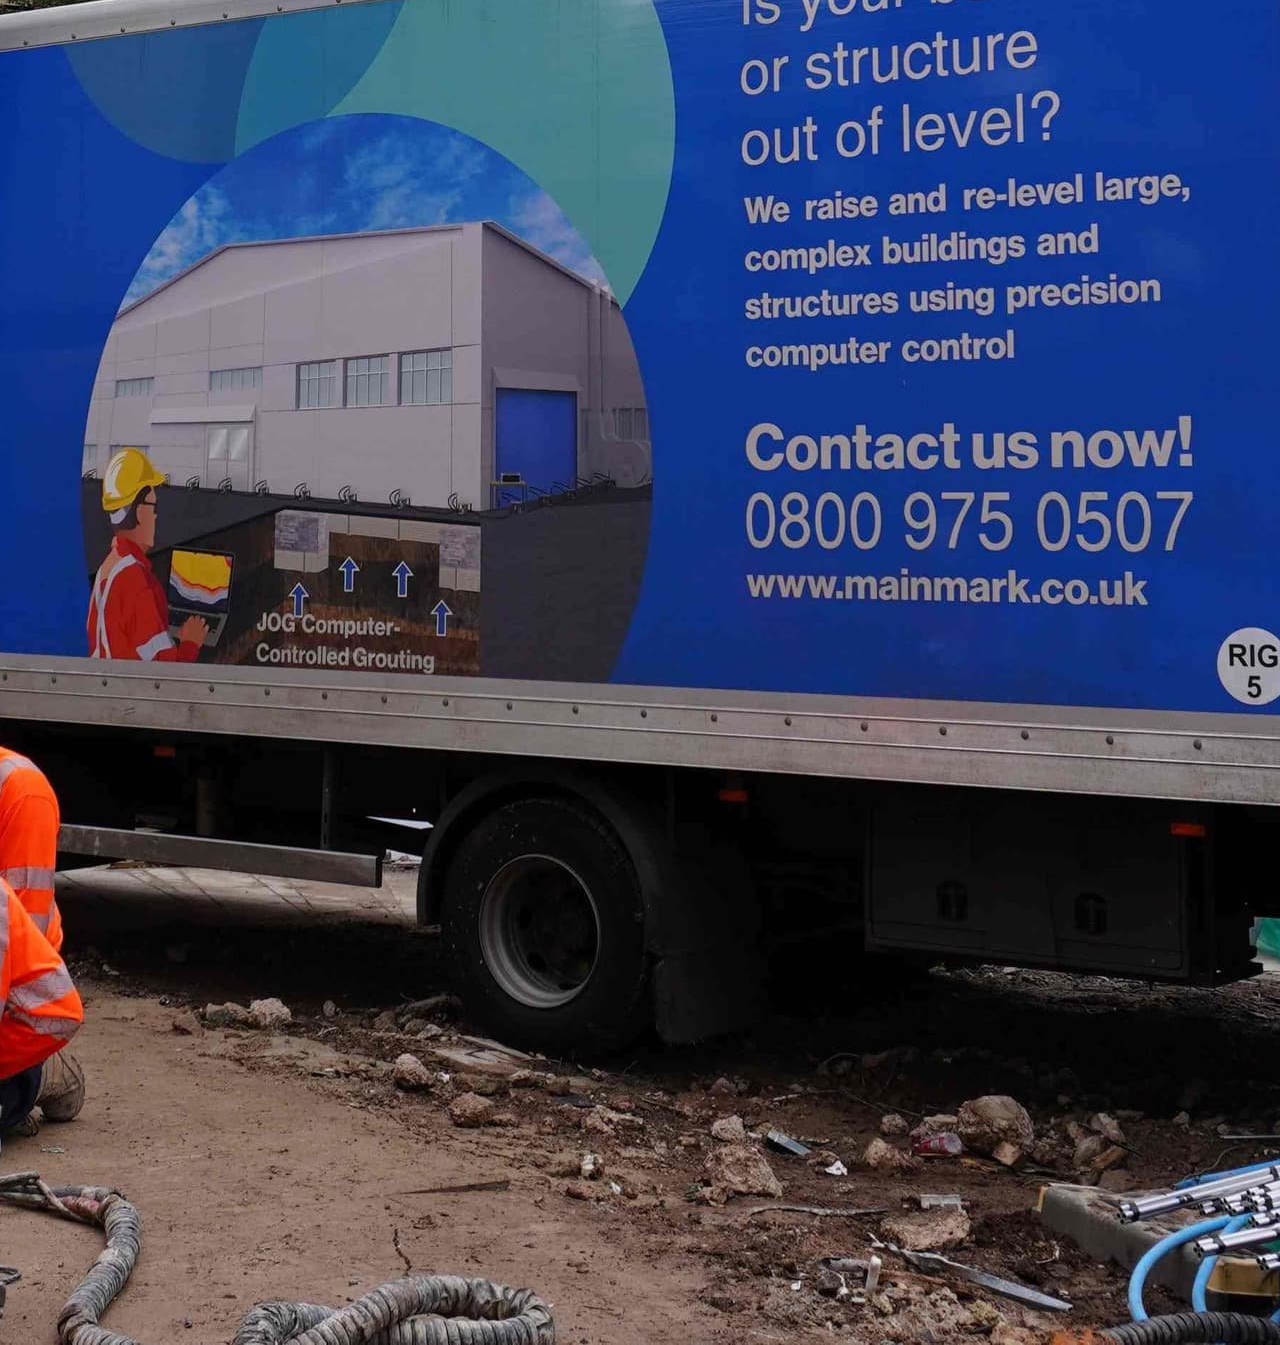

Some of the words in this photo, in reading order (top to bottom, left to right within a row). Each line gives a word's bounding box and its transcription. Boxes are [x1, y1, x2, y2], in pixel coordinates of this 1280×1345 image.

[741, 56, 788, 94] or
[805, 30, 1038, 89] structure
[742, 117, 817, 165] out
[837, 106, 882, 157] of
[903, 91, 1059, 151] level?
[745, 196, 789, 223] We
[806, 191, 877, 220] raise
[889, 184, 945, 215] and
[964, 174, 1082, 209] re-level
[1096, 172, 1189, 204] large,
[745, 240, 871, 274] complex
[883, 232, 1025, 264] buildings
[1038, 224, 1098, 255] and
[746, 290, 898, 319] structures
[911, 282, 994, 315] using
[1008, 274, 1160, 313] precision
[746, 338, 890, 370] computer
[902, 330, 1014, 361] control
[746, 423, 960, 470] Contact
[973, 432, 1038, 469] us
[1052, 416, 1192, 467] now!
[747, 492, 881, 549] 0800
[904, 492, 1012, 550] 975
[1038, 492, 1193, 552] 0507
[747, 569, 1147, 605] www.mainmark.co.uk
[256, 612, 295, 634] JOG
[302, 612, 401, 638] Computer-
[256, 643, 350, 667] Controlled
[352, 648, 435, 675] Grouting
[1228, 644, 1278, 668] RIG
[1247, 676, 1262, 698] 5
